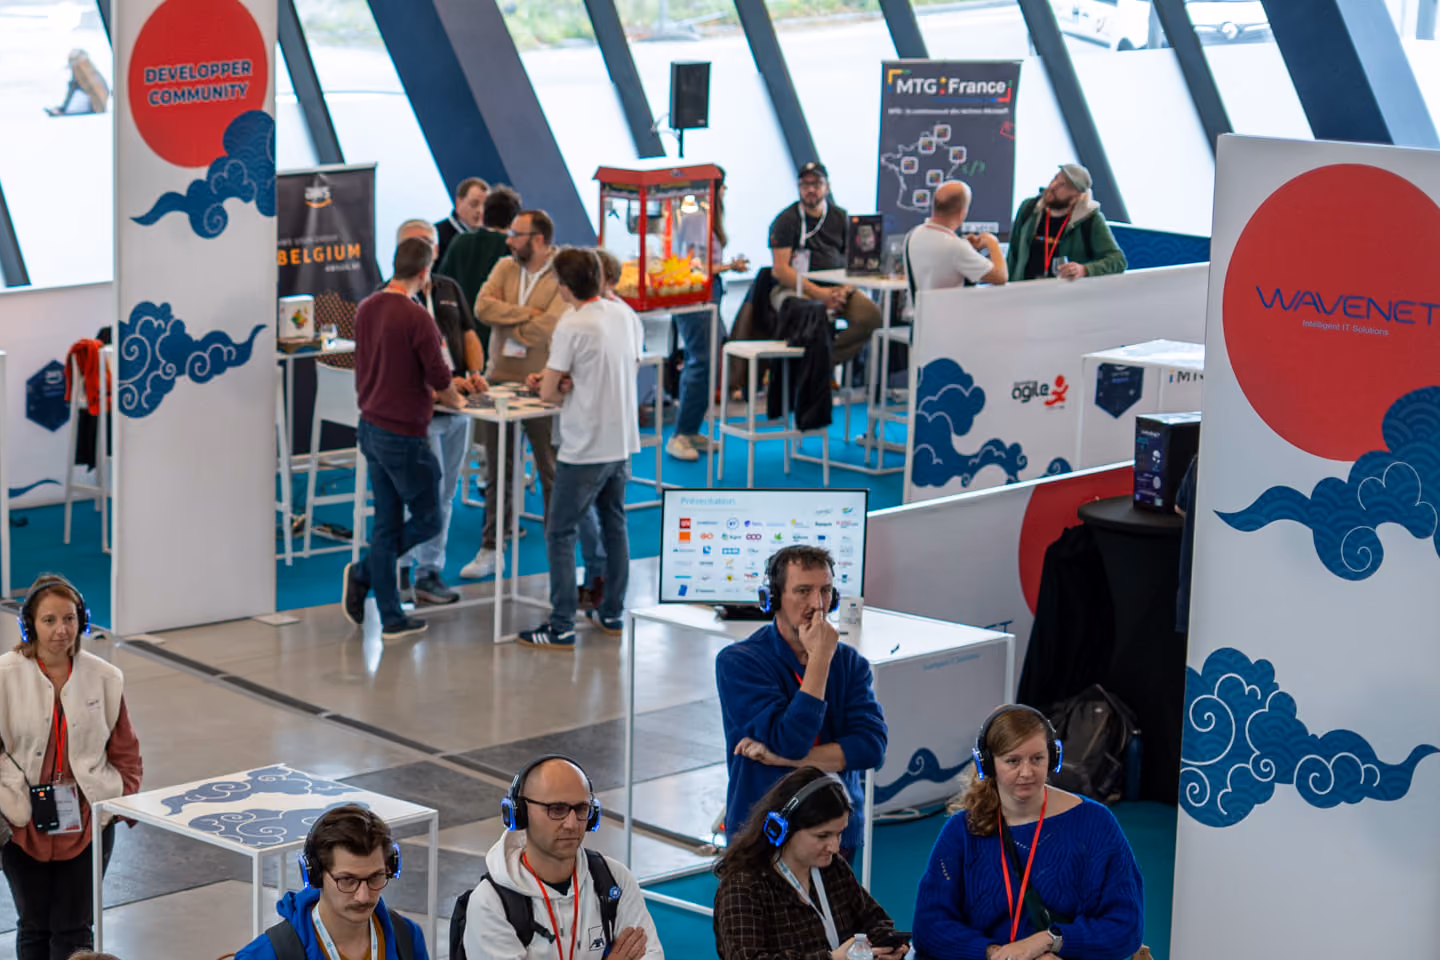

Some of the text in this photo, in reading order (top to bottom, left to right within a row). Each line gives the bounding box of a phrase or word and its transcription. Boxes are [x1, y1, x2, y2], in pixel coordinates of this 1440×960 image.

[144, 60, 252, 84] DEVELOPPER
[148, 83, 248, 106] COMMUNITY
[948, 78, 1007, 95] France
[277, 243, 361, 266] BELGIUM
[1256, 285, 1440, 326] WAVENET
[1302, 319, 1389, 337] Intelligent IT Solutions
[1012, 380, 1050, 404] agile
